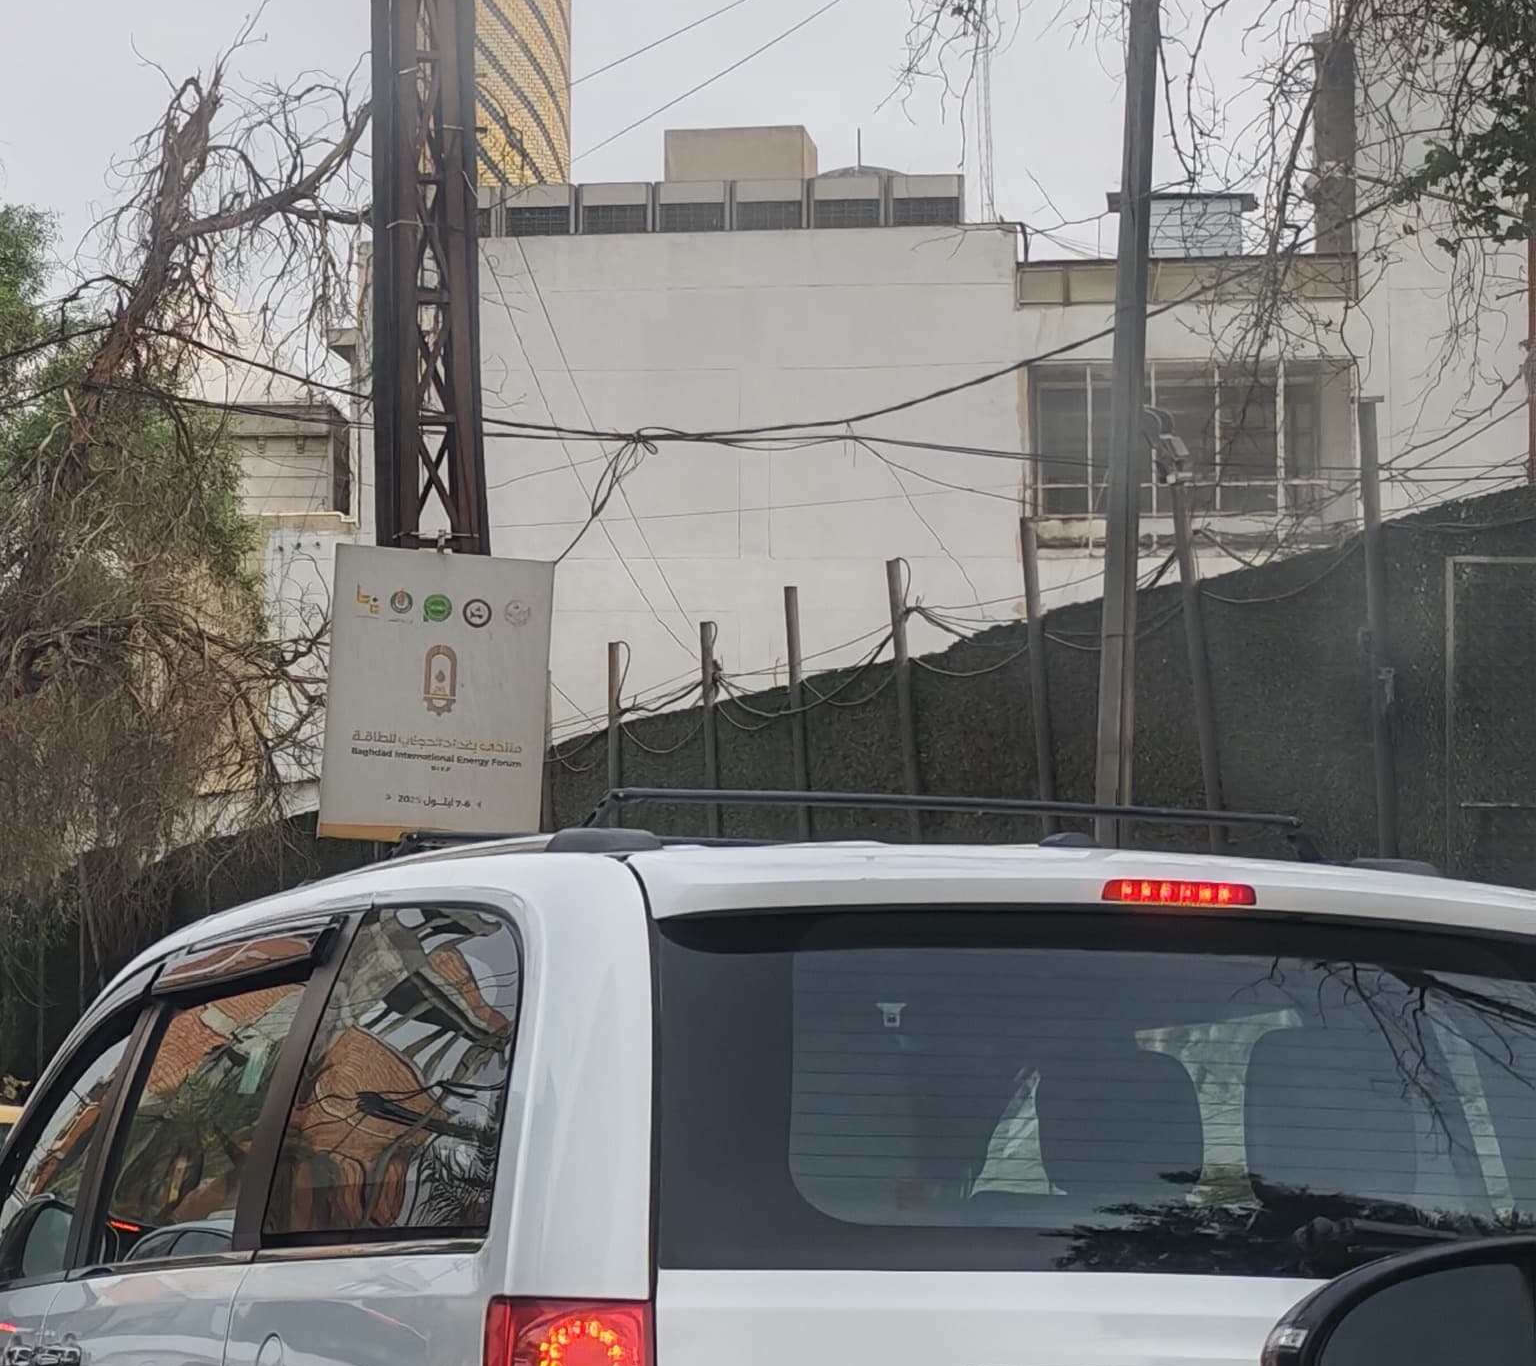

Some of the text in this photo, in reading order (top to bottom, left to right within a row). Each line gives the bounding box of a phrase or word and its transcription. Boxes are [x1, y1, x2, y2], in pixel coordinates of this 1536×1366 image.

[351, 747, 522, 768] Baghdad International Energy Forum
